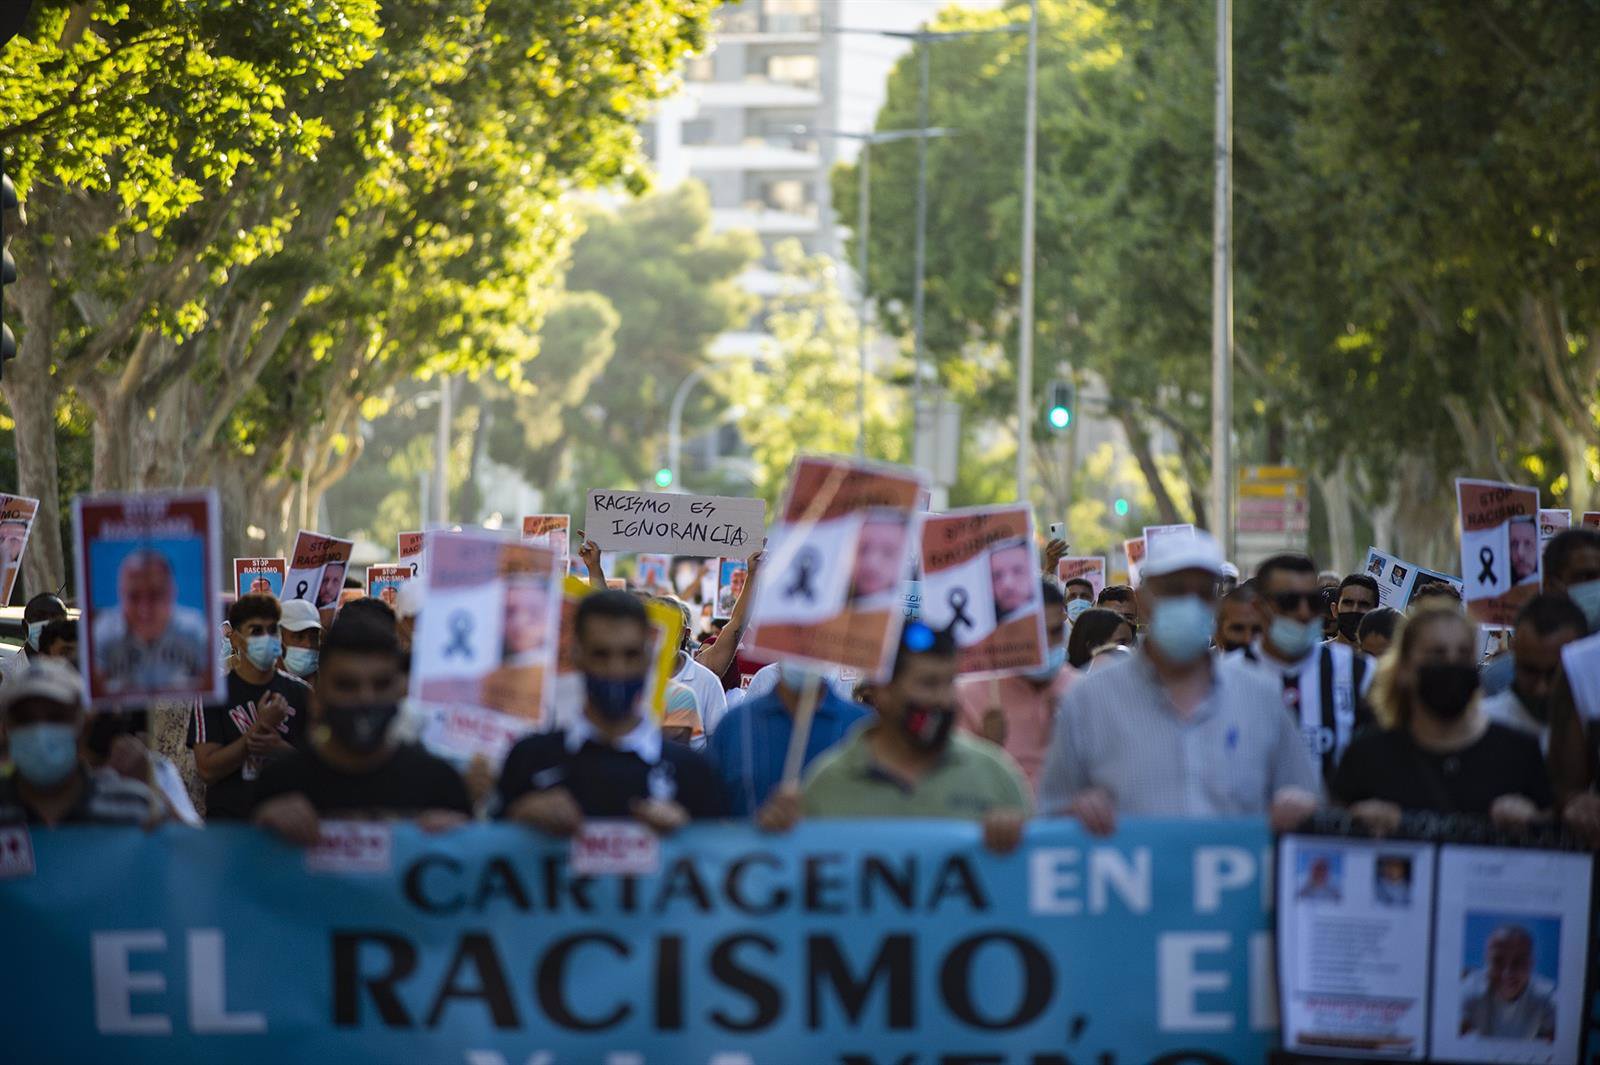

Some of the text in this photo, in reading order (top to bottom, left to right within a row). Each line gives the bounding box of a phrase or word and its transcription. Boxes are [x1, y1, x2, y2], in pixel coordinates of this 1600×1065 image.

[593, 494, 716, 519] RACISMO ES
[1468, 503, 1525, 524] RACISMO
[612, 518, 748, 547] IGNORANCIA
[310, 539, 338, 552] STOP
[243, 566, 278, 574] RASCISMO
[404, 853, 988, 917] CARTAGENA
[1030, 847, 1152, 914] EN
[92, 929, 267, 1034] EL
[332, 929, 1088, 1041] RACISMO,
